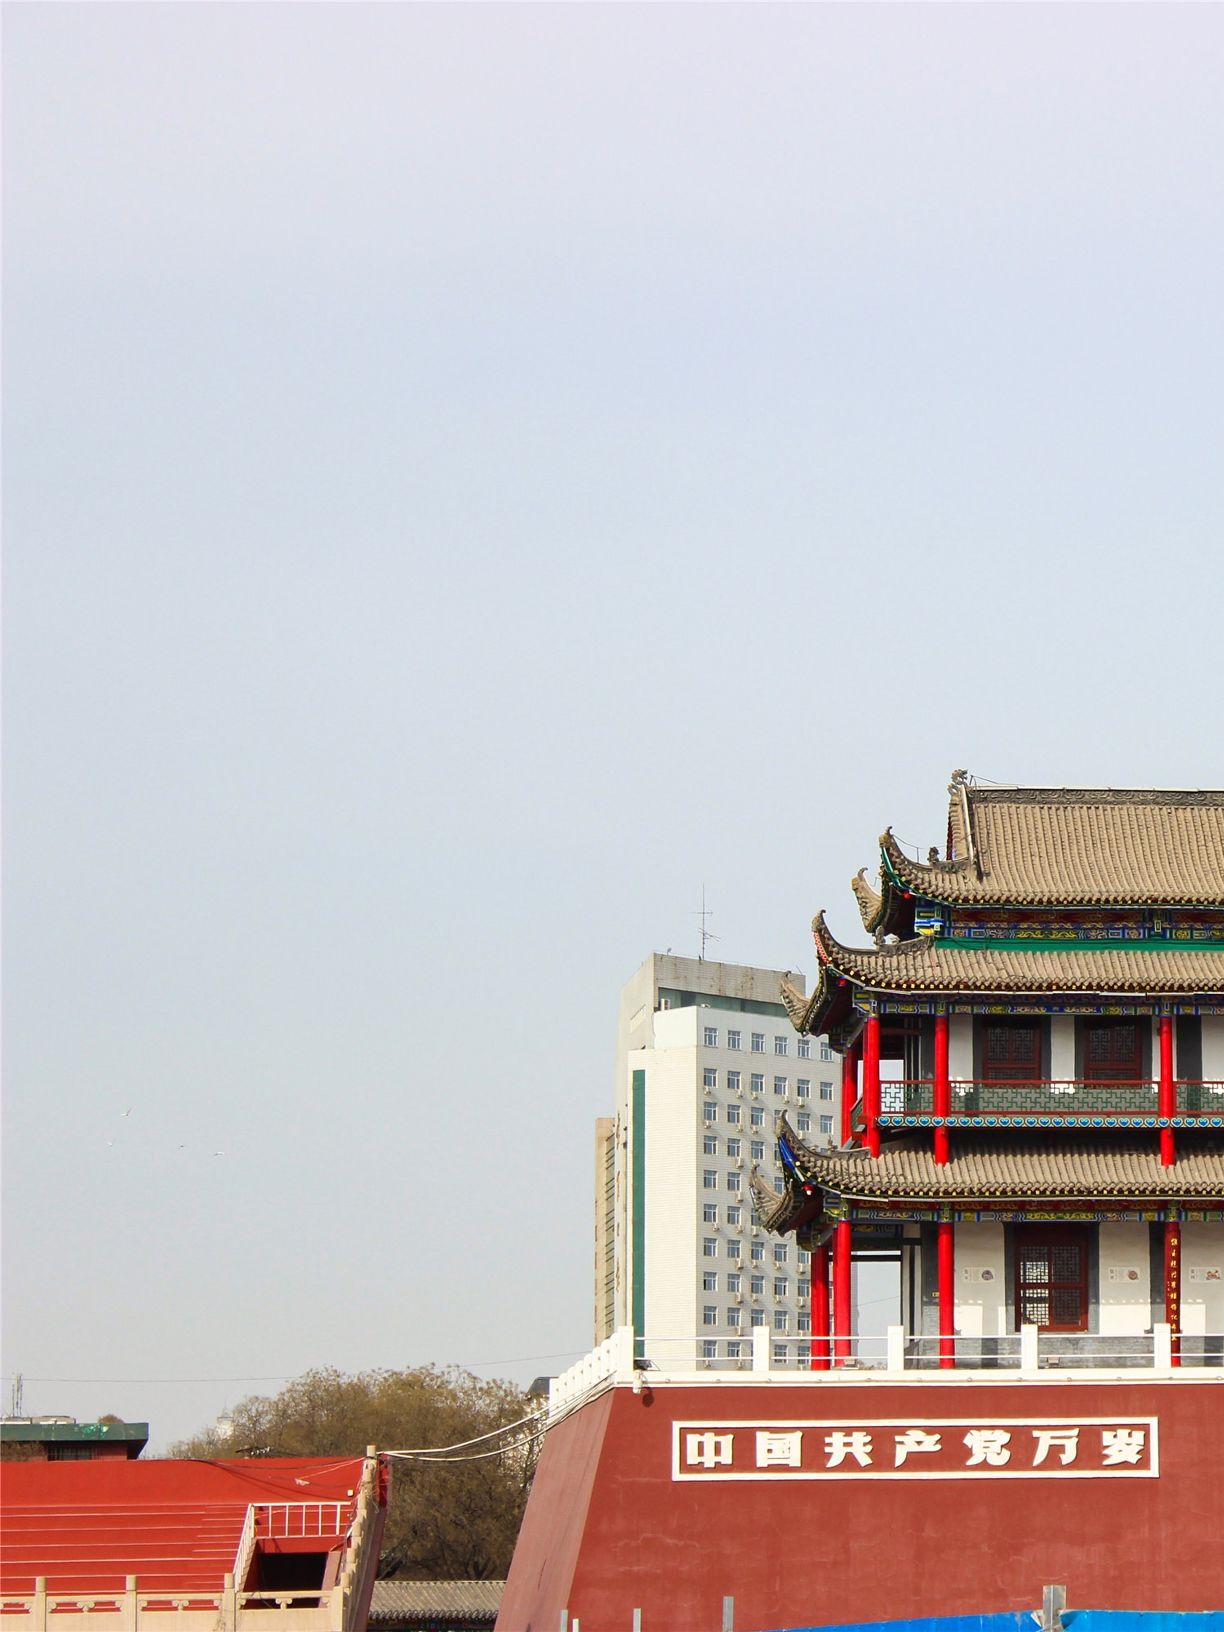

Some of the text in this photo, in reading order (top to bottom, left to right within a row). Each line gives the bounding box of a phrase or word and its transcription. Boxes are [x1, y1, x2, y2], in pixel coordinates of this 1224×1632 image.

[686, 1429, 1146, 1468] 中国共产党万岁
